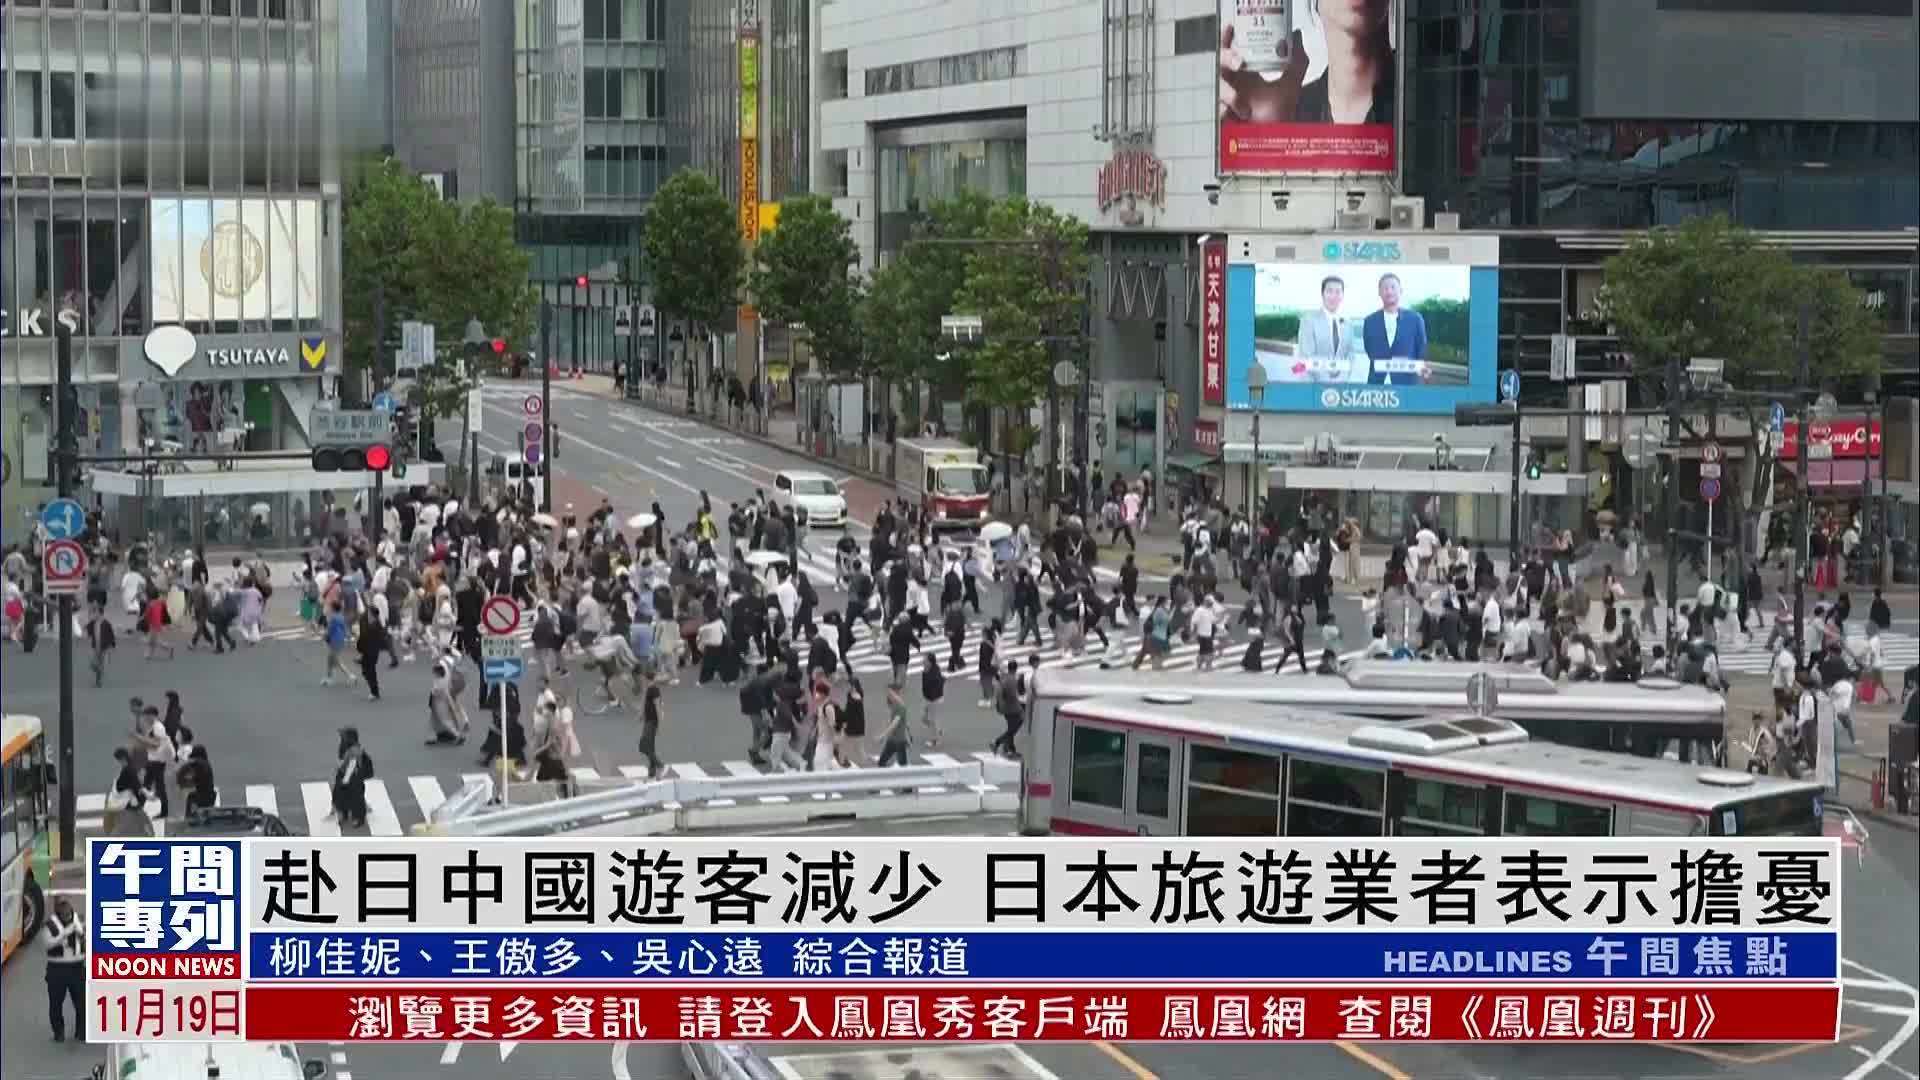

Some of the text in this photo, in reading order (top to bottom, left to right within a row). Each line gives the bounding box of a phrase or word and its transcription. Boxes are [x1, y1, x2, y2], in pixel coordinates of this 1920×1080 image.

[745, 138, 755, 187] TOUCH
[1343, 240, 1402, 259] STARTS
[207, 348, 290, 365] TSUTAYA
[1341, 389, 1401, 409] STARTS
